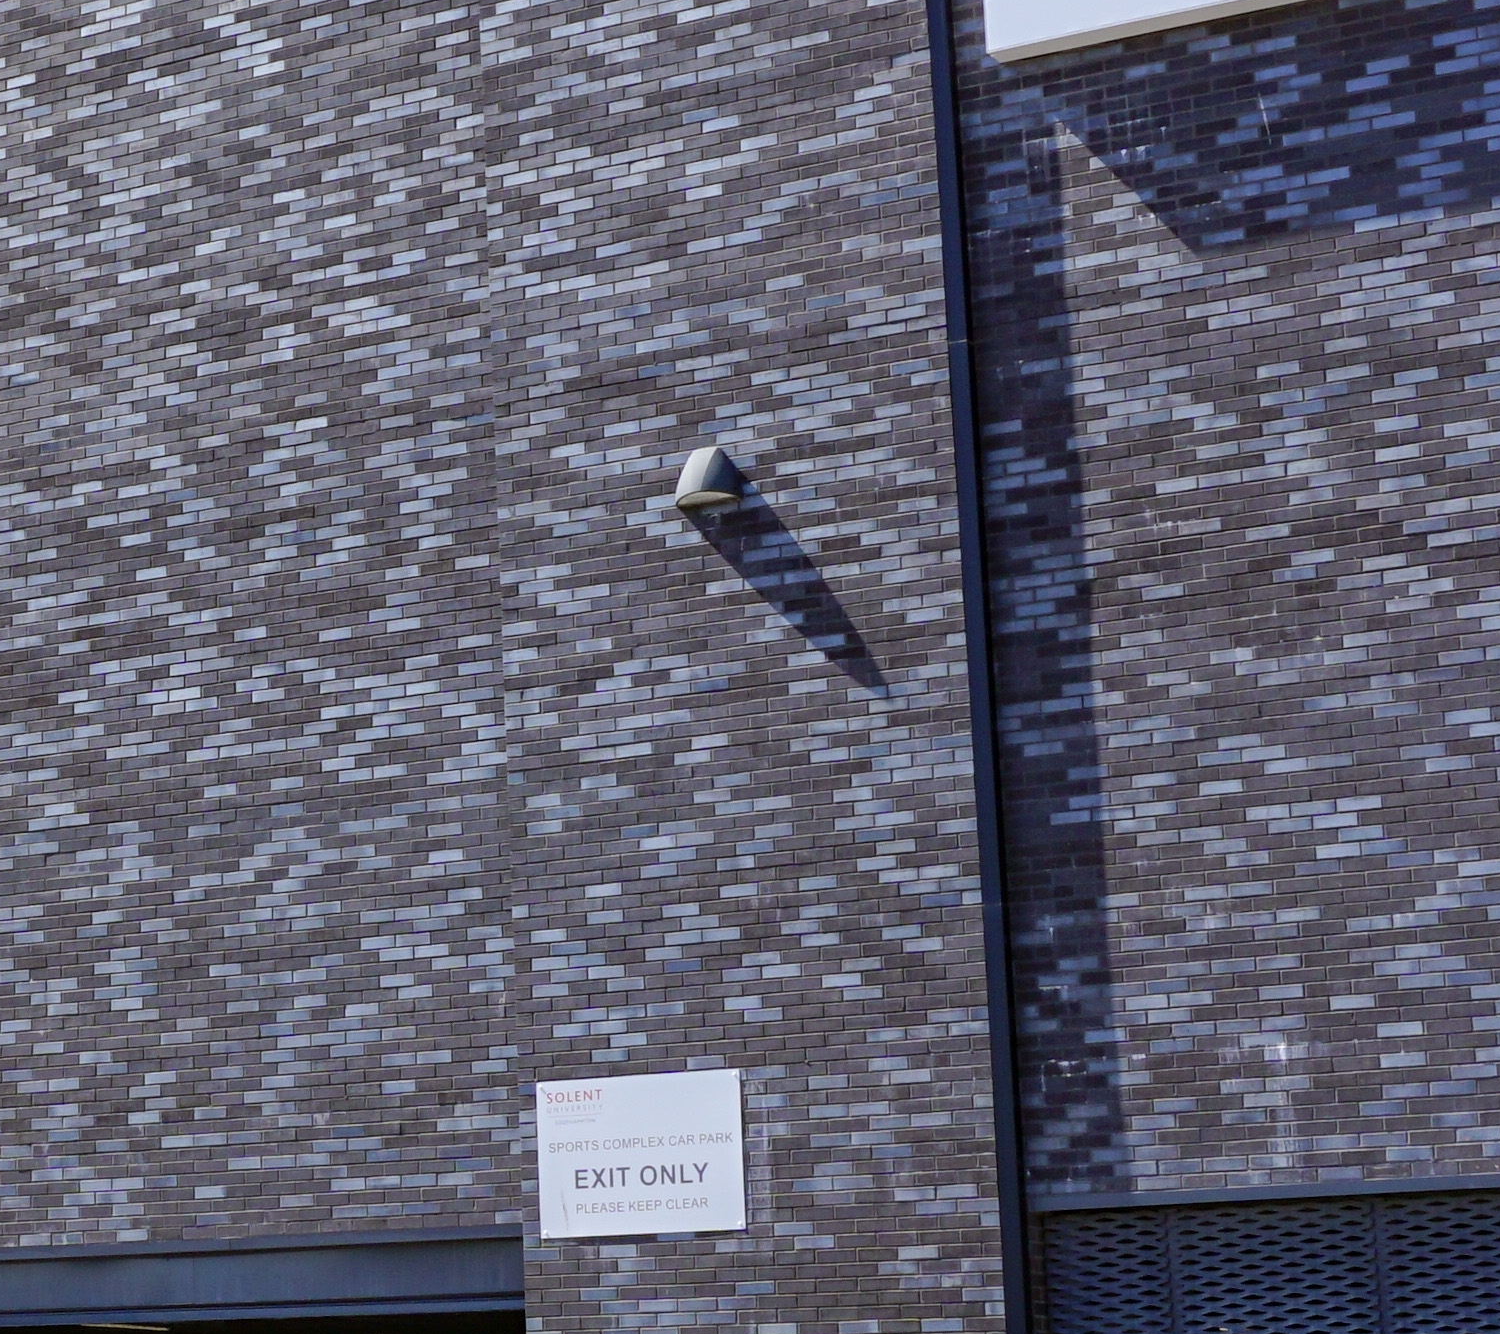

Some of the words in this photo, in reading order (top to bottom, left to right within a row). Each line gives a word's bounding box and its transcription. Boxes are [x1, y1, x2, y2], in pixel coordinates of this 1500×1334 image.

[546, 1089, 603, 1104] SOLENT
[546, 1103, 603, 1114] UNIVERSITY
[548, 1140, 600, 1154] SPORTS
[602, 1136, 665, 1151] COMPLEX
[668, 1134, 695, 1147] CAR
[699, 1132, 734, 1146] PARK
[574, 1167, 631, 1190] EXIT
[639, 1162, 709, 1187] ONLY
[576, 1202, 625, 1215] PLEASE
[628, 1200, 662, 1213] KEEP
[665, 1197, 709, 1210] CLEAR
